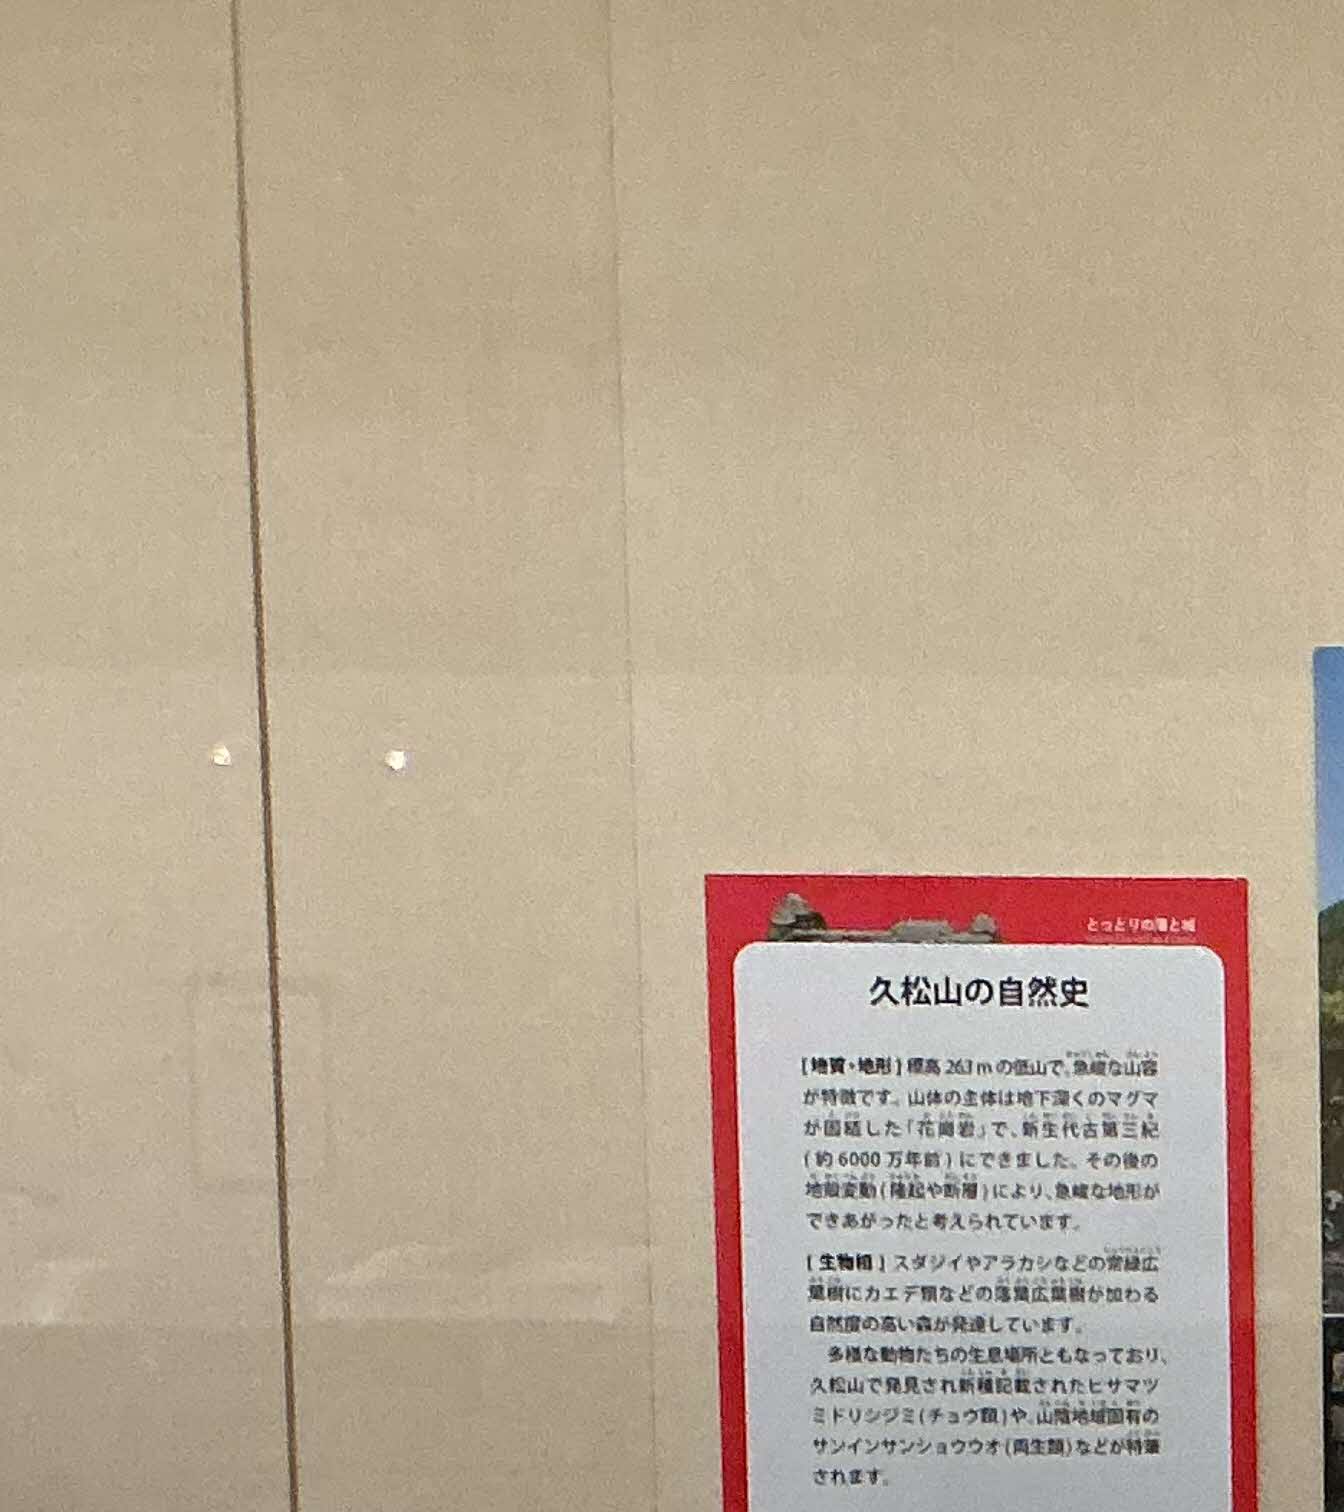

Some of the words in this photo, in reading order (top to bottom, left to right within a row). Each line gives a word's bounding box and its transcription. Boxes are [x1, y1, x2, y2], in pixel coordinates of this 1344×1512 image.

[869, 975, 1091, 1008] 久松山の自然史
[807, 1212, 1081, 1232] できあがったと考えられています。
[809, 1315, 1082, 1335] 自然度の高い森が発達しています。
[810, 1376, 1160, 1396] 久松山で発見され新種記載されたヒサマツ
[813, 1468, 891, 1488] されます。
